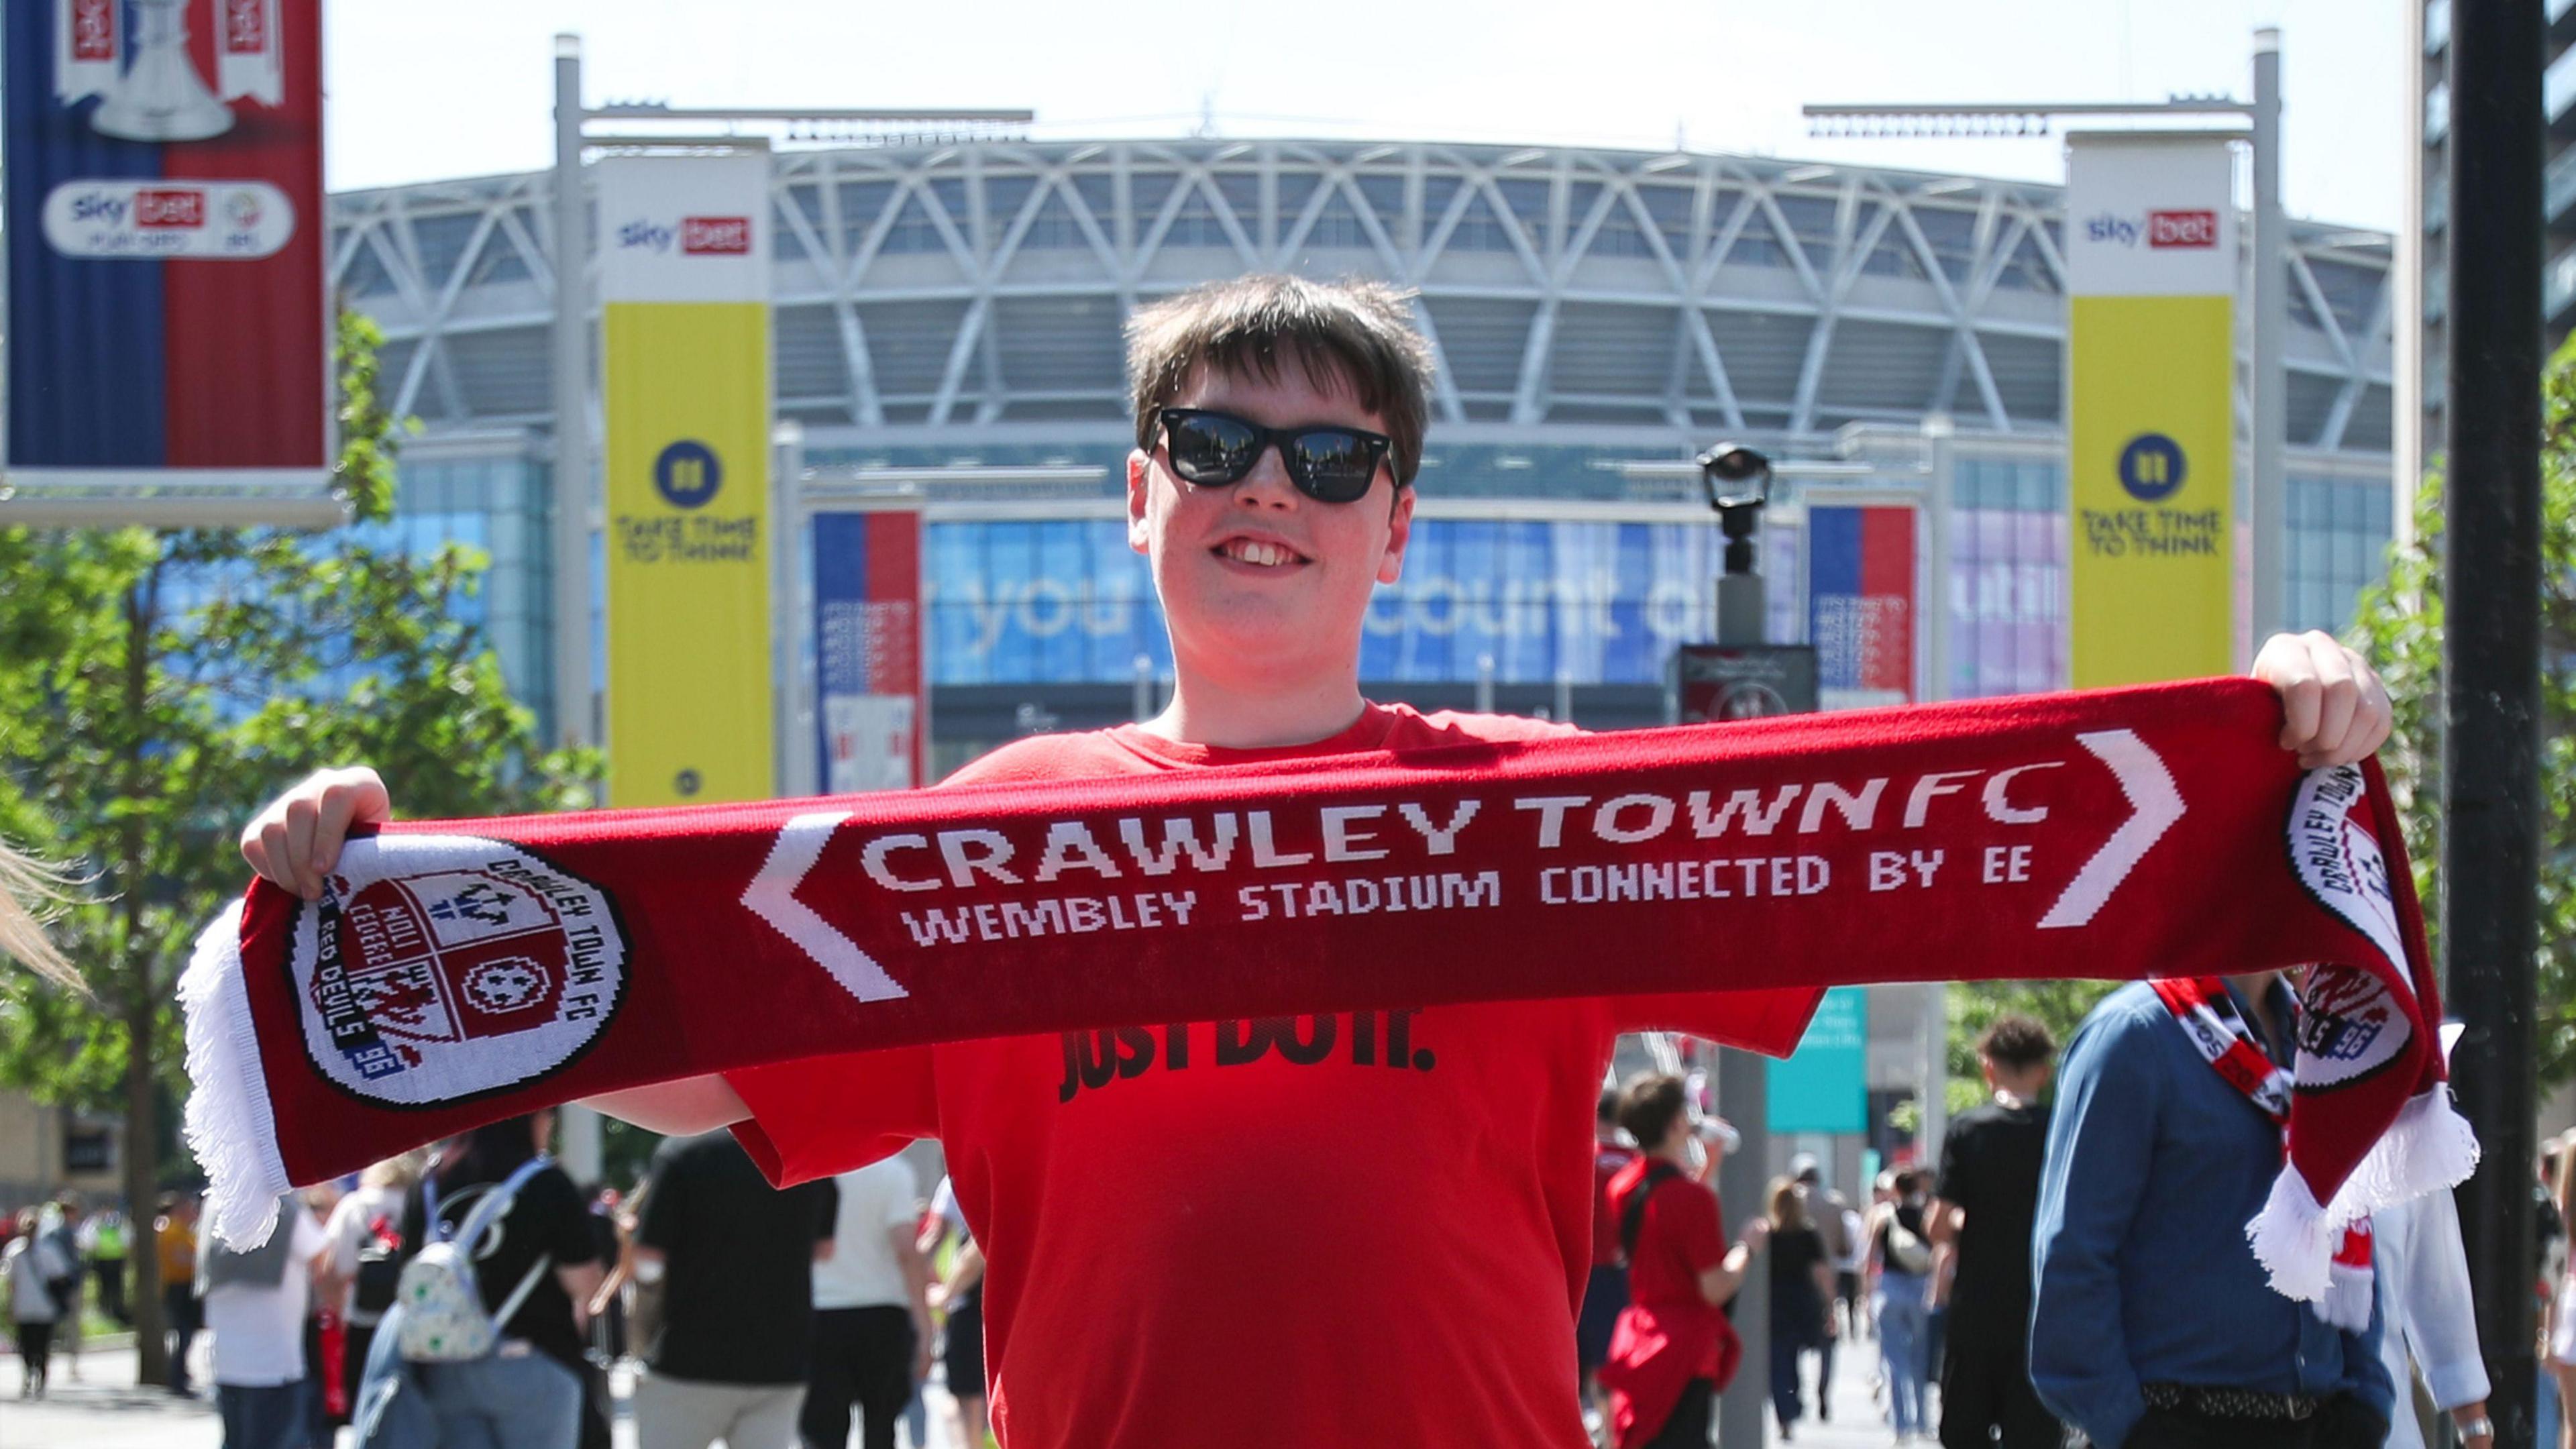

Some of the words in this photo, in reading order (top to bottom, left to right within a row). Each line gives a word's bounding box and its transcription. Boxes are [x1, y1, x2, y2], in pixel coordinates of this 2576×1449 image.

[72, 193, 126, 226] sky
[140, 192, 201, 223] bet
[617, 217, 678, 254] sky
[685, 219, 745, 251] bet
[2087, 213, 2145, 248] sky
[2154, 213, 2215, 244] bet
[692, 515, 756, 538] TIME
[2081, 508, 2147, 535] TAKE
[2157, 508, 2221, 533] TIME
[625, 537, 661, 562] TO
[669, 537, 754, 562] THINK
[2088, 535, 2127, 557] TO
[2134, 534, 2218, 557] THINK
[966, 578, 1130, 656] you
[2312, 765, 2363, 808] TOWN
[861, 800, 1481, 892] CRAWLEY
[2304, 810, 2353, 894] CRAWLEY
[901, 891, 1197, 947] WEMBLEY
[1238, 871, 1500, 921] STADIUM
[1540, 855, 1830, 904] CONNECTED
[1870, 849, 1944, 892] BY
[1983, 845, 2033, 883] EE
[320, 919, 337, 961] RED
[569, 924, 605, 986] TOWN
[320, 964, 366, 1037] DEVILS
[565, 993, 600, 1022] FC
[1059, 1021, 1189, 1104] JUST
[1215, 1012, 1338, 1067] DO
[2333, 1025, 2372, 1057] 96
[354, 1046, 395, 1075] 96
